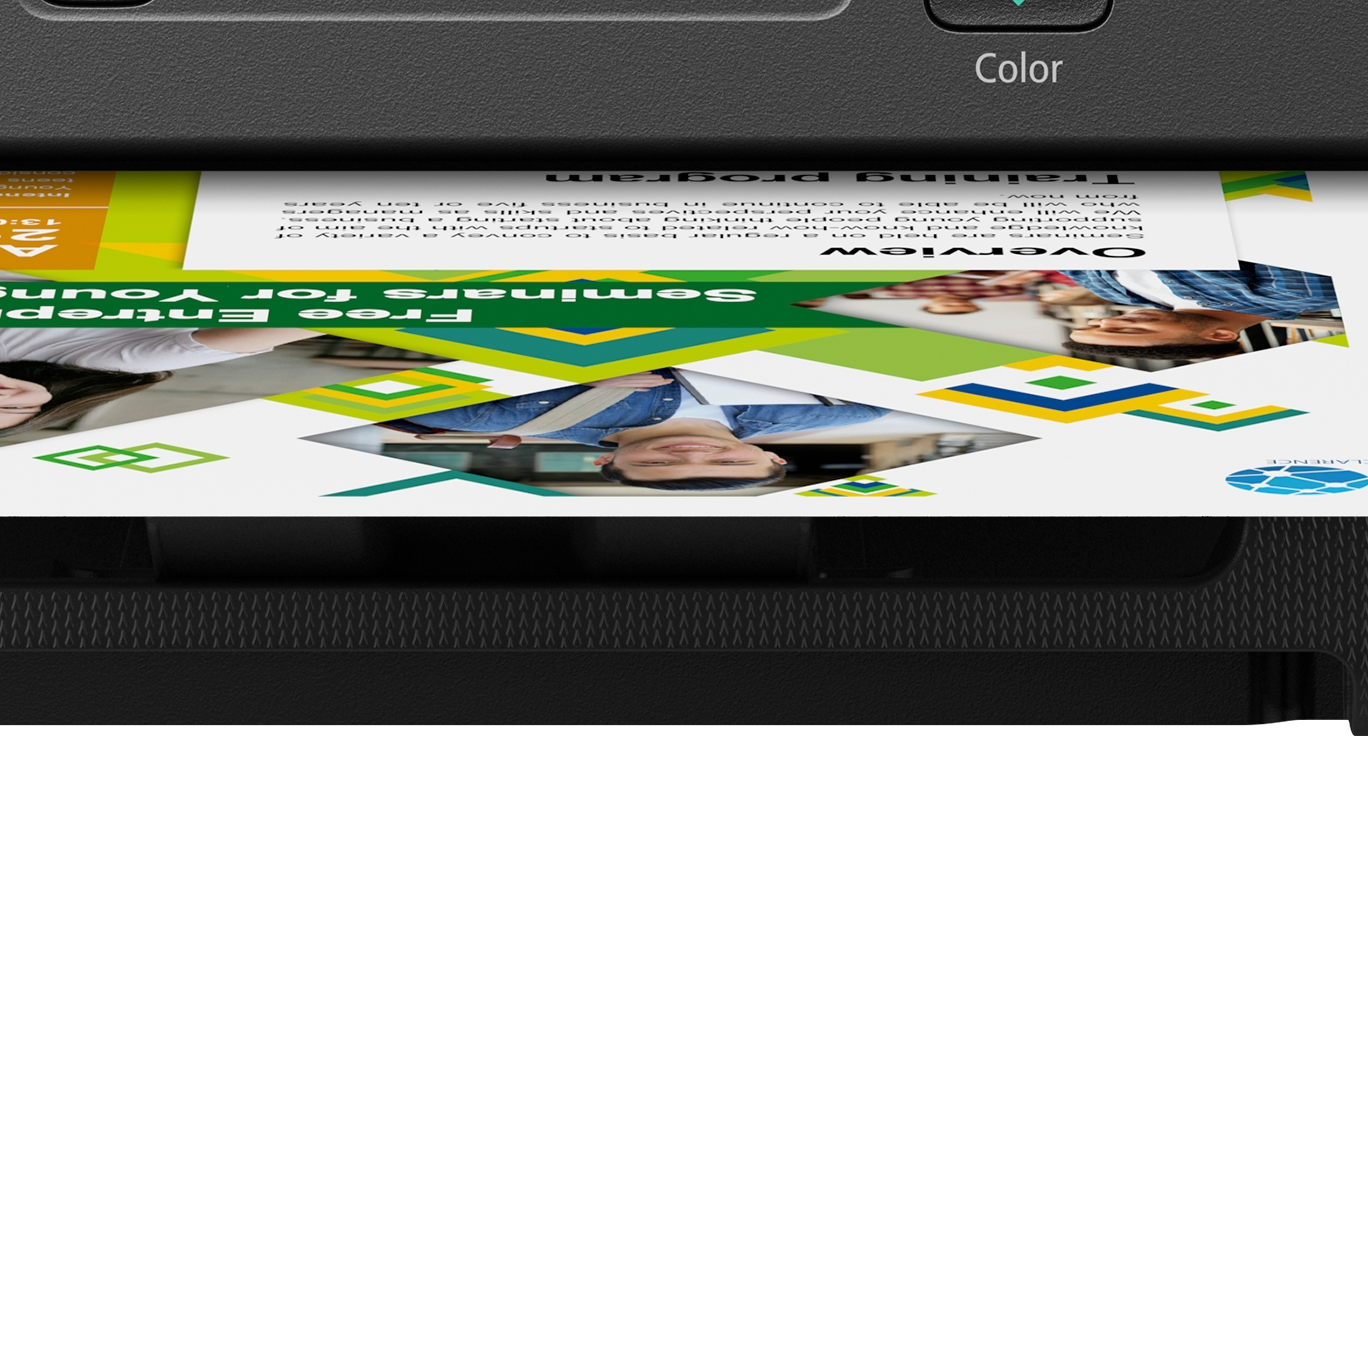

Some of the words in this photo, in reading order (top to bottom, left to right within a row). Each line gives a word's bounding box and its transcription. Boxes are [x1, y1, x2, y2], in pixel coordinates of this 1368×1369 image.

[975, 50, 1064, 84] Color
[545, 171, 830, 183] program
[855, 171, 1136, 185] Training
[631, 208, 812, 216] perspectives
[663, 216, 773, 224] thinking
[785, 216, 882, 224] people
[819, 246, 1147, 259] Overview
[240, 288, 358, 303] for
[382, 288, 758, 303] Seminars
[297, 308, 473, 323] Free
